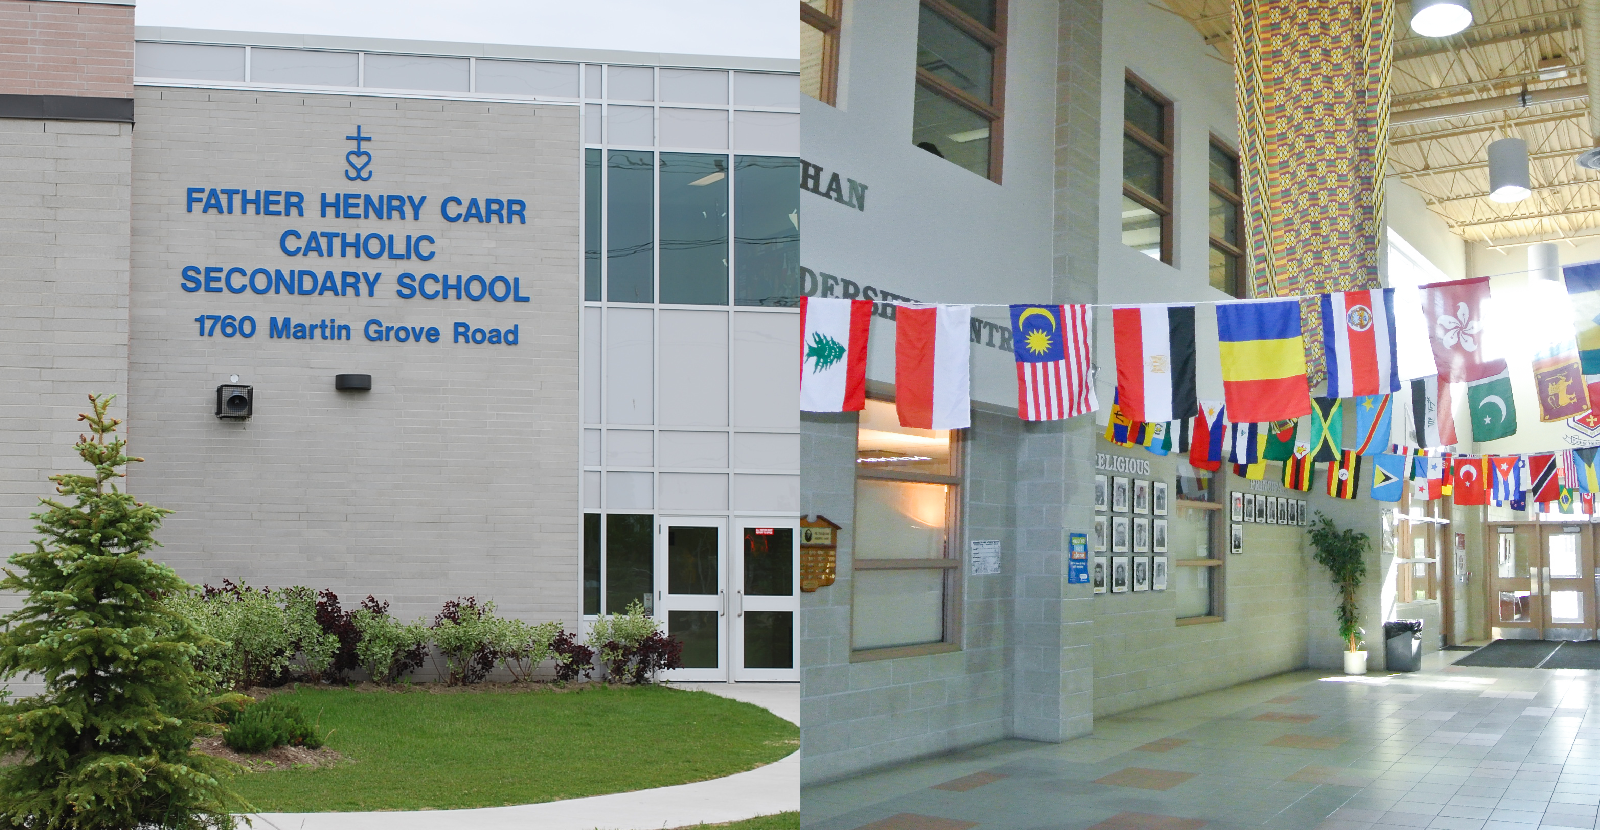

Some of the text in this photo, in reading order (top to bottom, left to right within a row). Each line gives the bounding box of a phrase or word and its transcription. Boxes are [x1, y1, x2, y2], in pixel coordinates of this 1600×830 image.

[800, 158, 869, 212] HAN
[186, 187, 527, 224] FATHER HENRY CARR
[279, 229, 436, 261] CATHOLIC
[180, 265, 531, 302] SECONDARY SCHOOL
[194, 314, 519, 345] 1760 Martin Grove Road
[1095, 452, 1150, 475] ELIGIOUS
